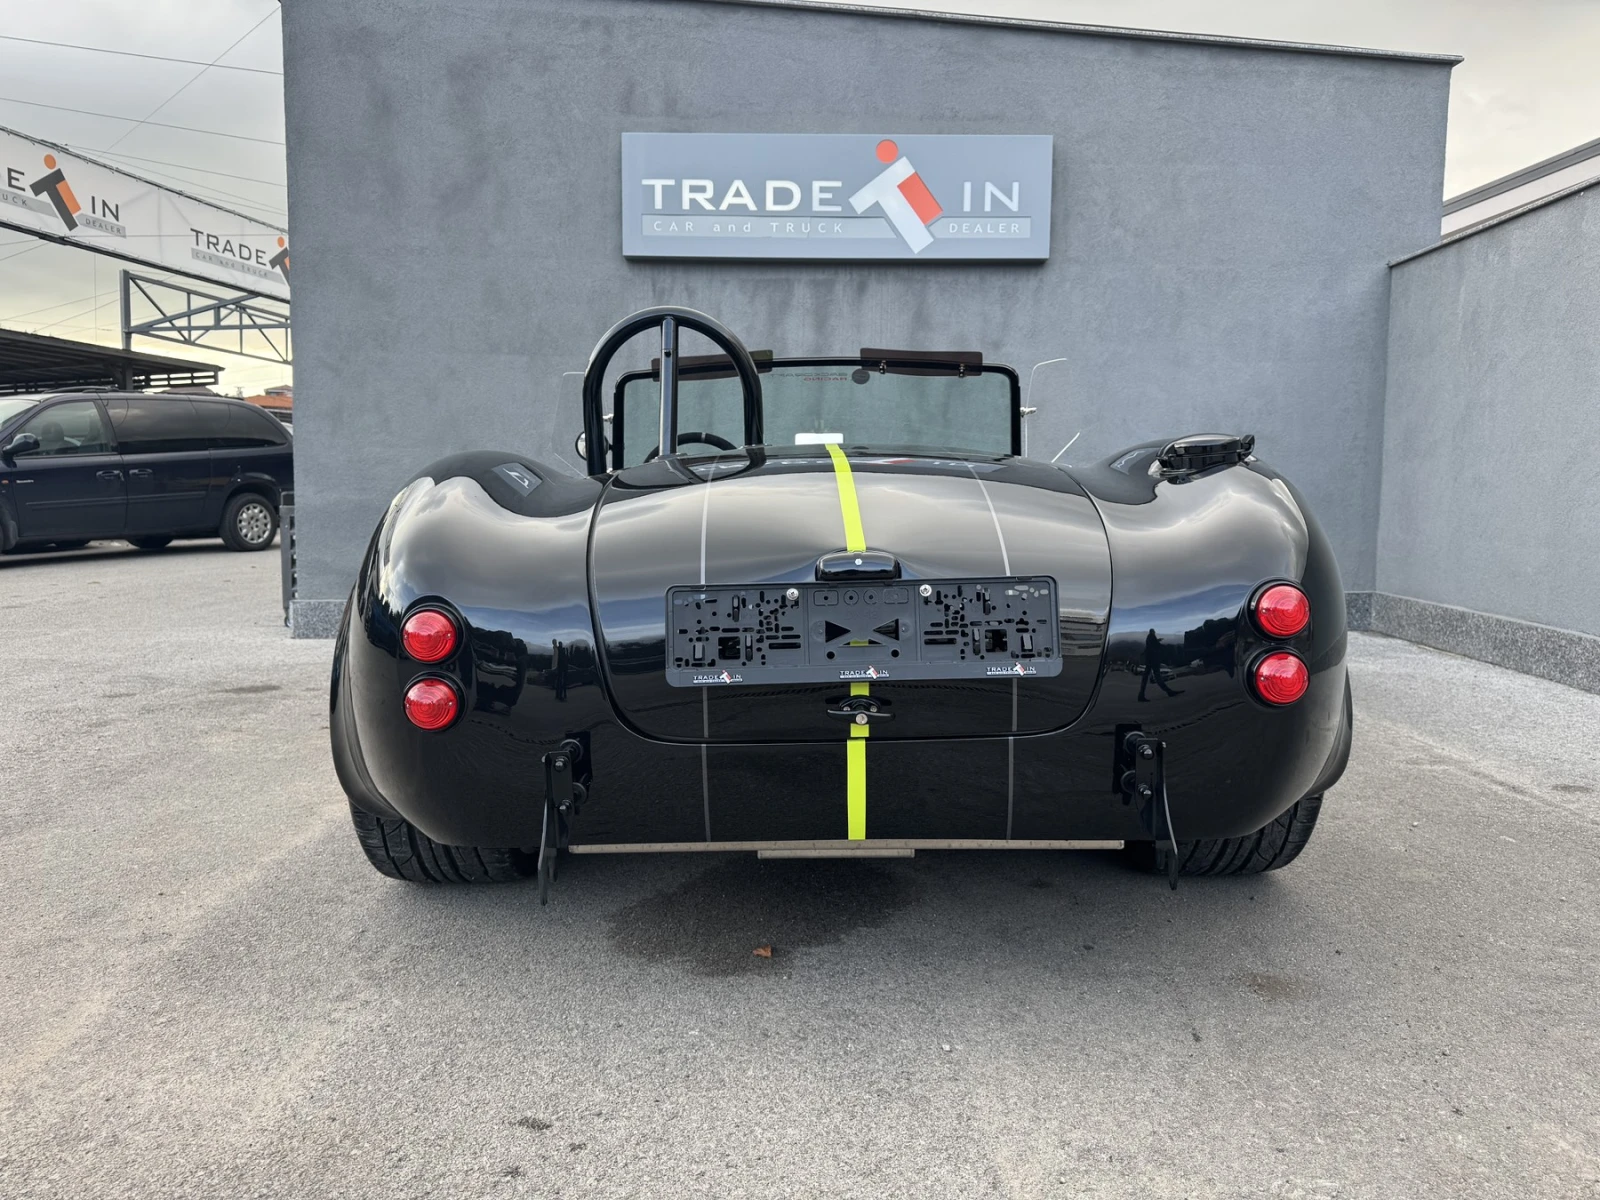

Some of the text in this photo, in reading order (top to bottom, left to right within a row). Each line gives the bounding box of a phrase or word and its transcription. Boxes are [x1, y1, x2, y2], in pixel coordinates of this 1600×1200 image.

[91, 195, 119, 222] IN
[641, 178, 843, 212] TRADE
[963, 181, 1020, 212] IN
[85, 217, 122, 235] DEALER
[653, 220, 1020, 233] CAR and TRUCK DEALER
[190, 228, 267, 266] TRADE
